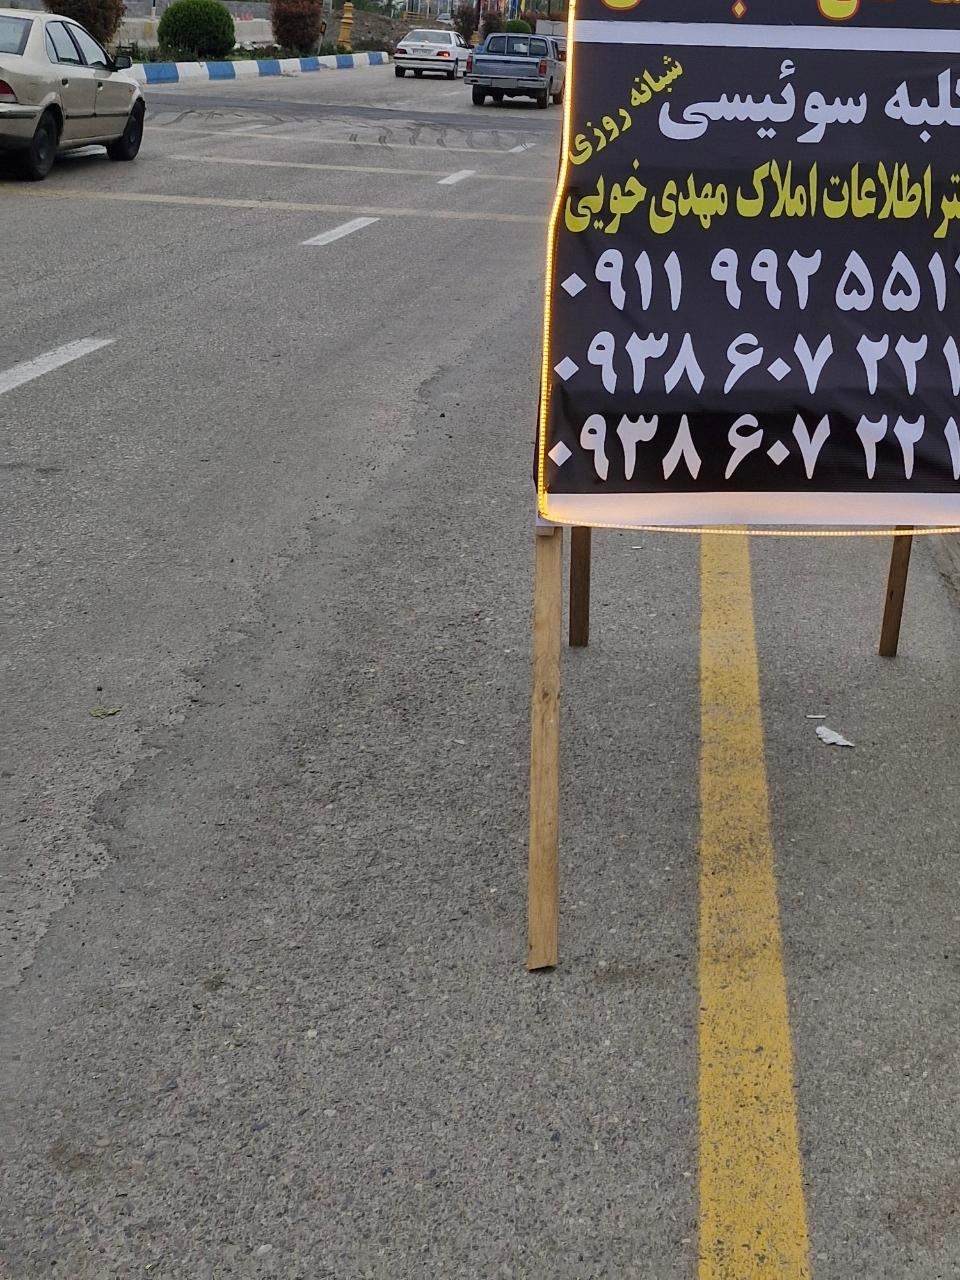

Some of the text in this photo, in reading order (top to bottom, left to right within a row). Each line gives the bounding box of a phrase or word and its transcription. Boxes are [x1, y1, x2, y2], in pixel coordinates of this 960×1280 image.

[569, 55, 684, 165] شبانه روزی
[658, 59, 867, 143] سوئیسی
[650, 172, 728, 234] مهدی
[736, 158, 818, 218] املاک
[822, 160, 932, 220] اطلاعات
[561, 248, 682, 312] ۰۹۱۱
